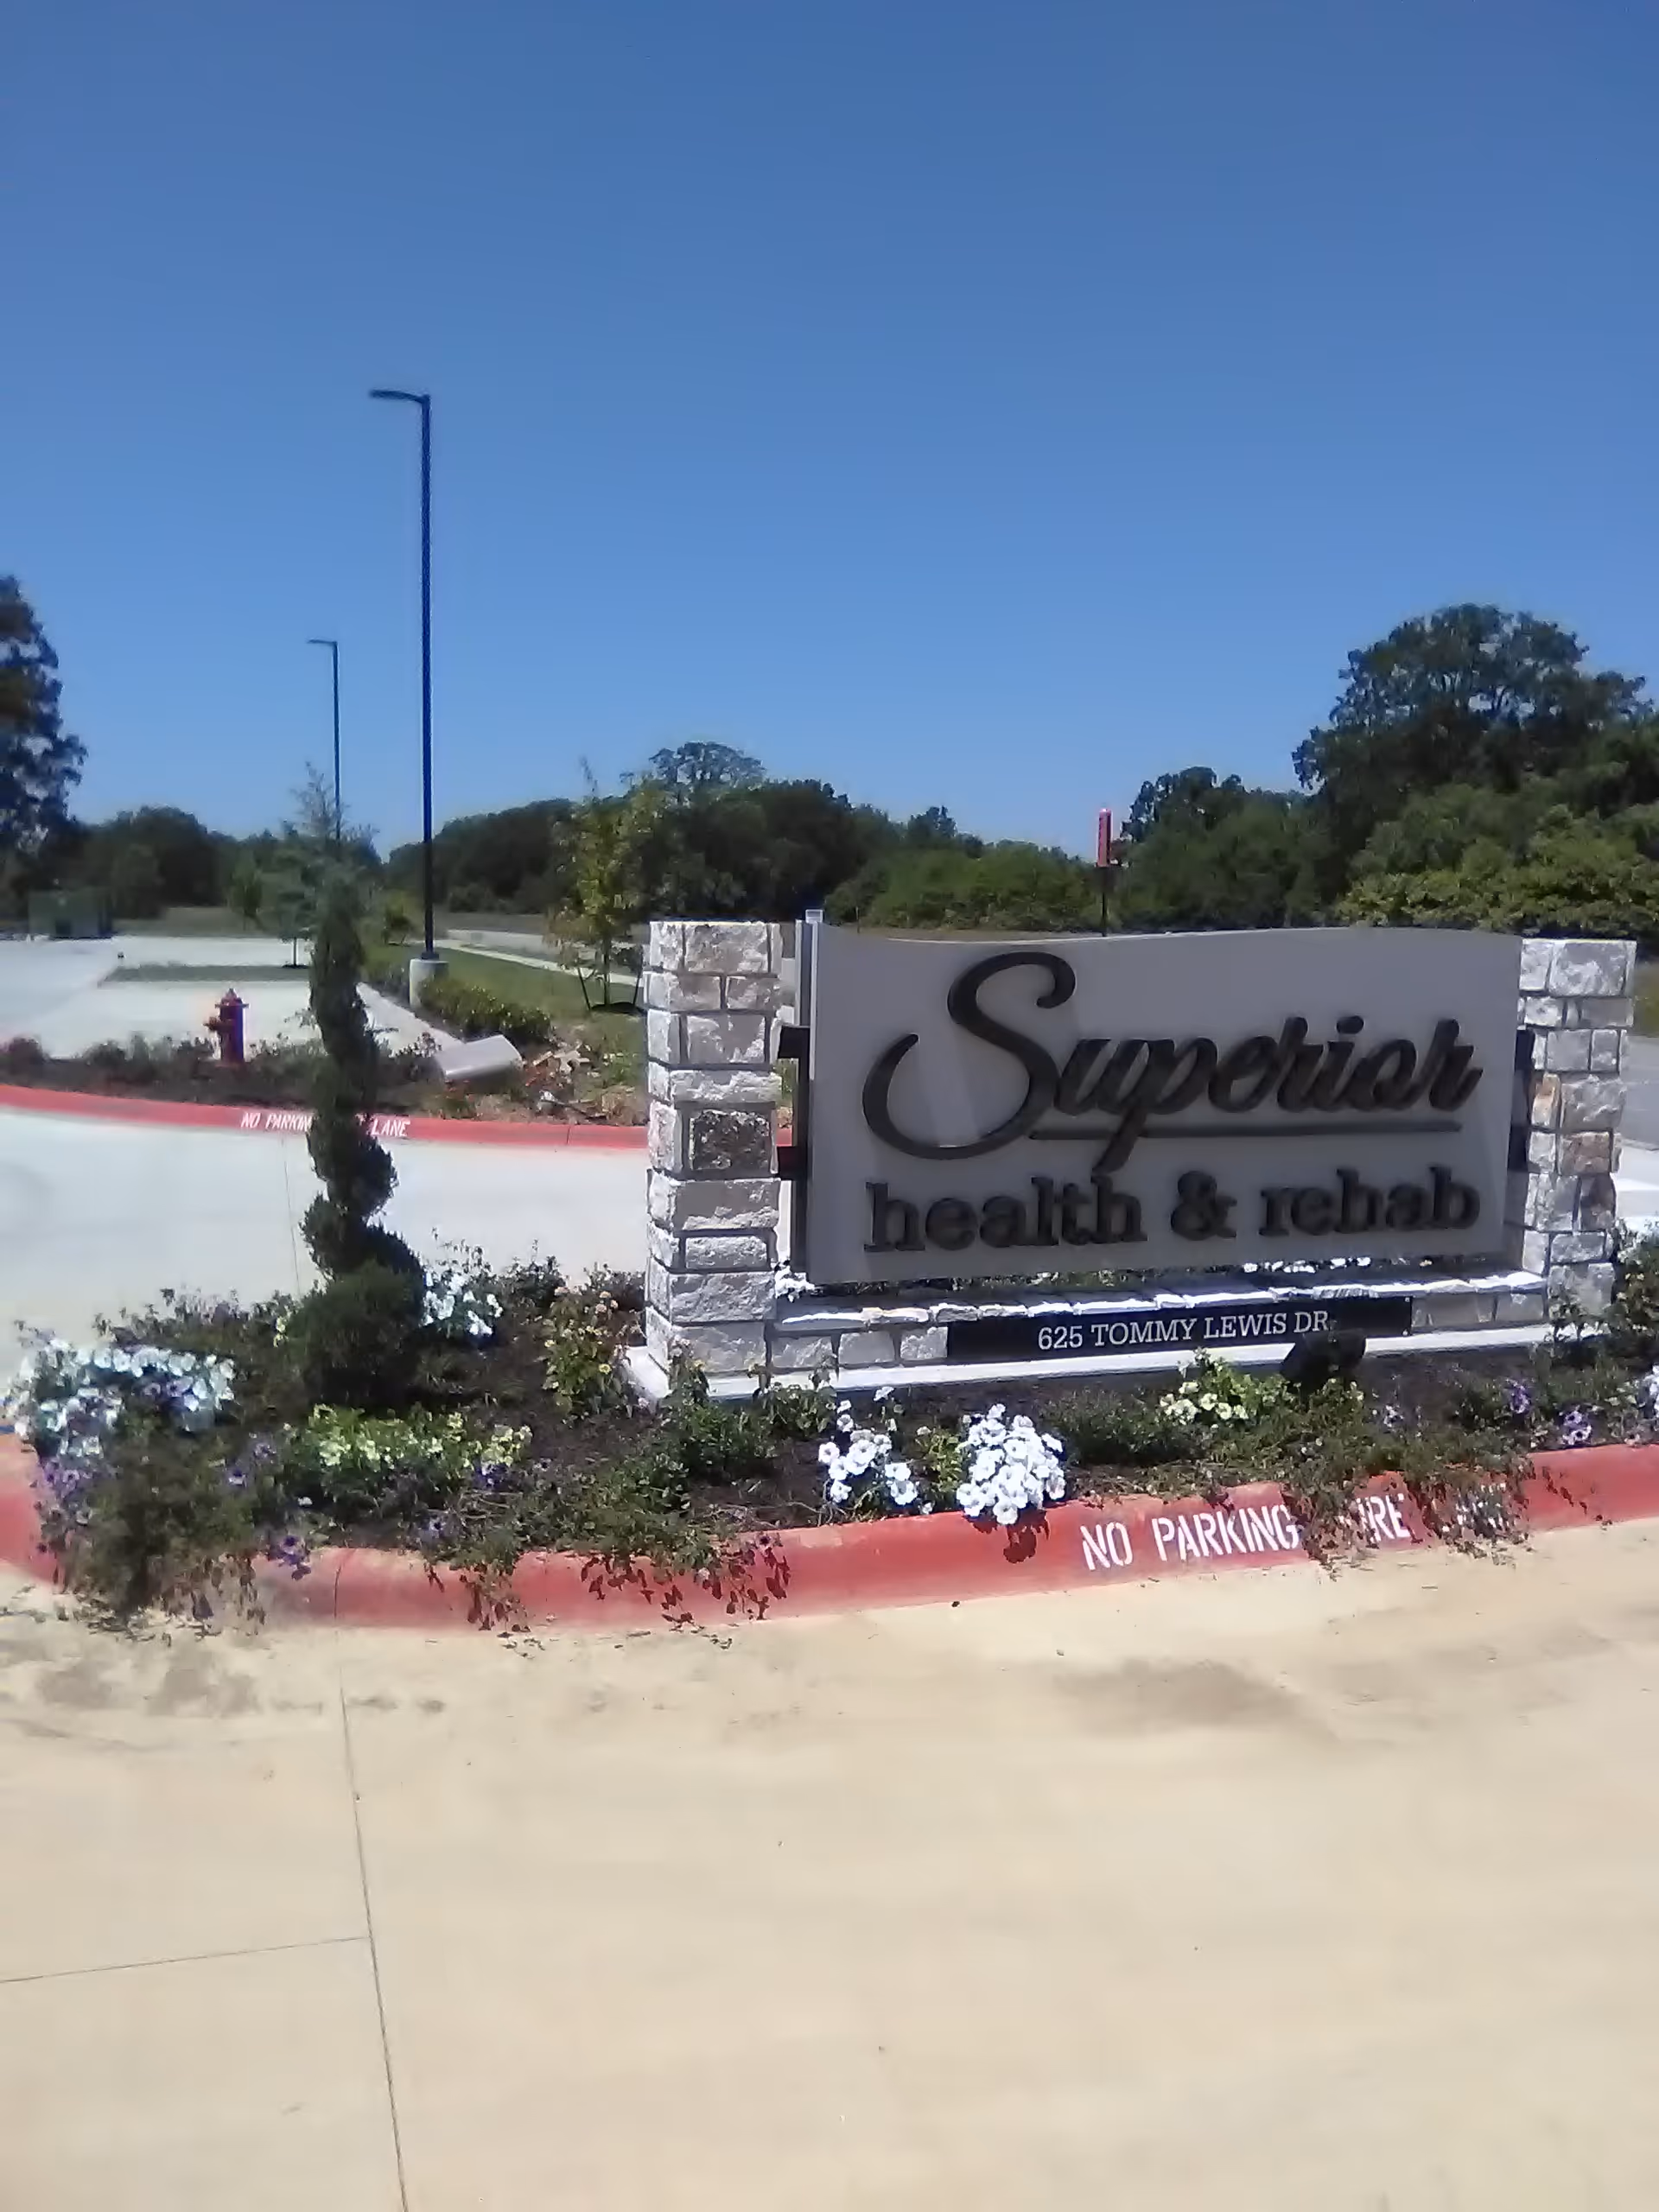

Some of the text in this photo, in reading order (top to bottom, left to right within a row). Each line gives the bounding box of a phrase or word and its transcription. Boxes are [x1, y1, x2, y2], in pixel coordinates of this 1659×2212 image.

[862, 951, 1484, 1173] Superior
[240, 1112, 260, 1129] NO
[264, 1113, 314, 1134] PARKIN
[371, 1117, 411, 1137] LANE
[864, 1165, 1482, 1252] health & rehab
[1038, 1325, 1083, 1351] 625
[1090, 1318, 1198, 1347] TOMMY
[1204, 1312, 1287, 1339] LEWIS
[1080, 1521, 1134, 1571] NO
[1152, 1503, 1300, 1562] PARKING
[1340, 1492, 1412, 1544] IRE
